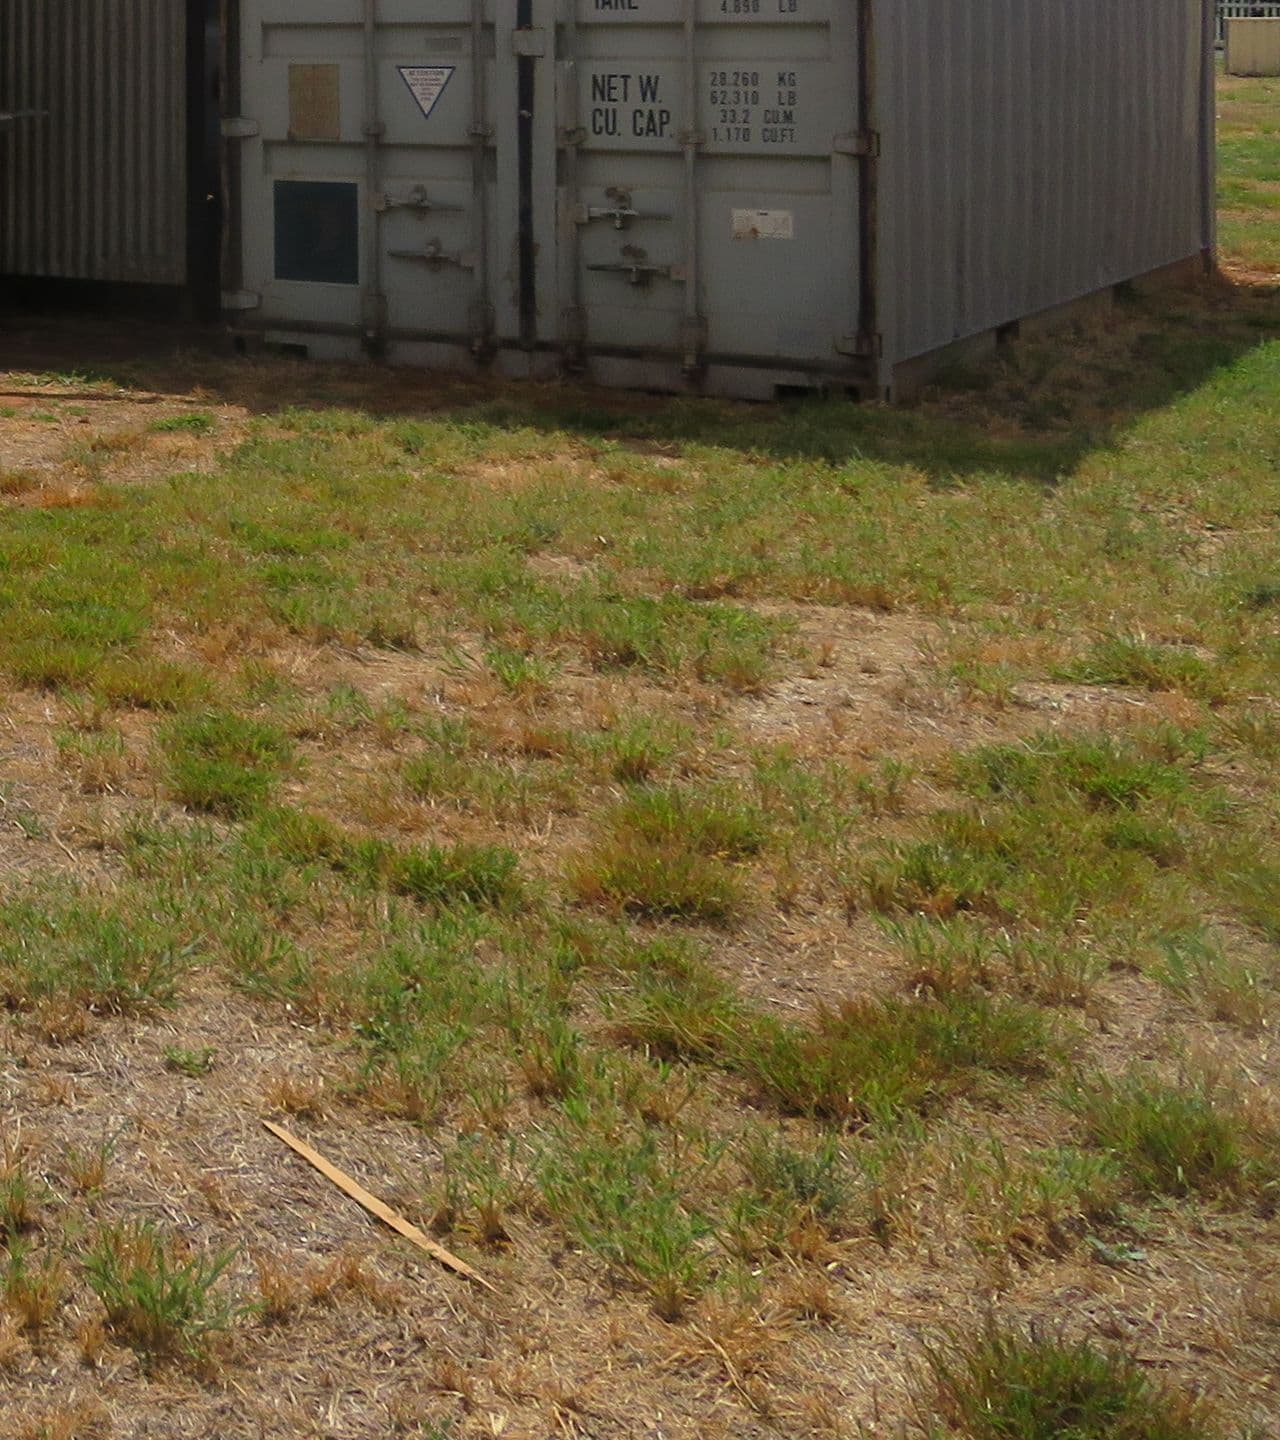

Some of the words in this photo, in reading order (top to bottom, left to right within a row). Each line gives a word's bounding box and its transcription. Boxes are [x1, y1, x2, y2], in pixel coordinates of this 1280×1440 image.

[591, 74, 632, 104] NET
[638, 75, 663, 104] W.
[777, 71, 798, 87] KG
[709, 90, 760, 106] 62.310
[777, 90, 798, 106] LB
[591, 107, 623, 137] CU.
[631, 108, 676, 138] CAP.
[719, 109, 753, 124] 33.2
